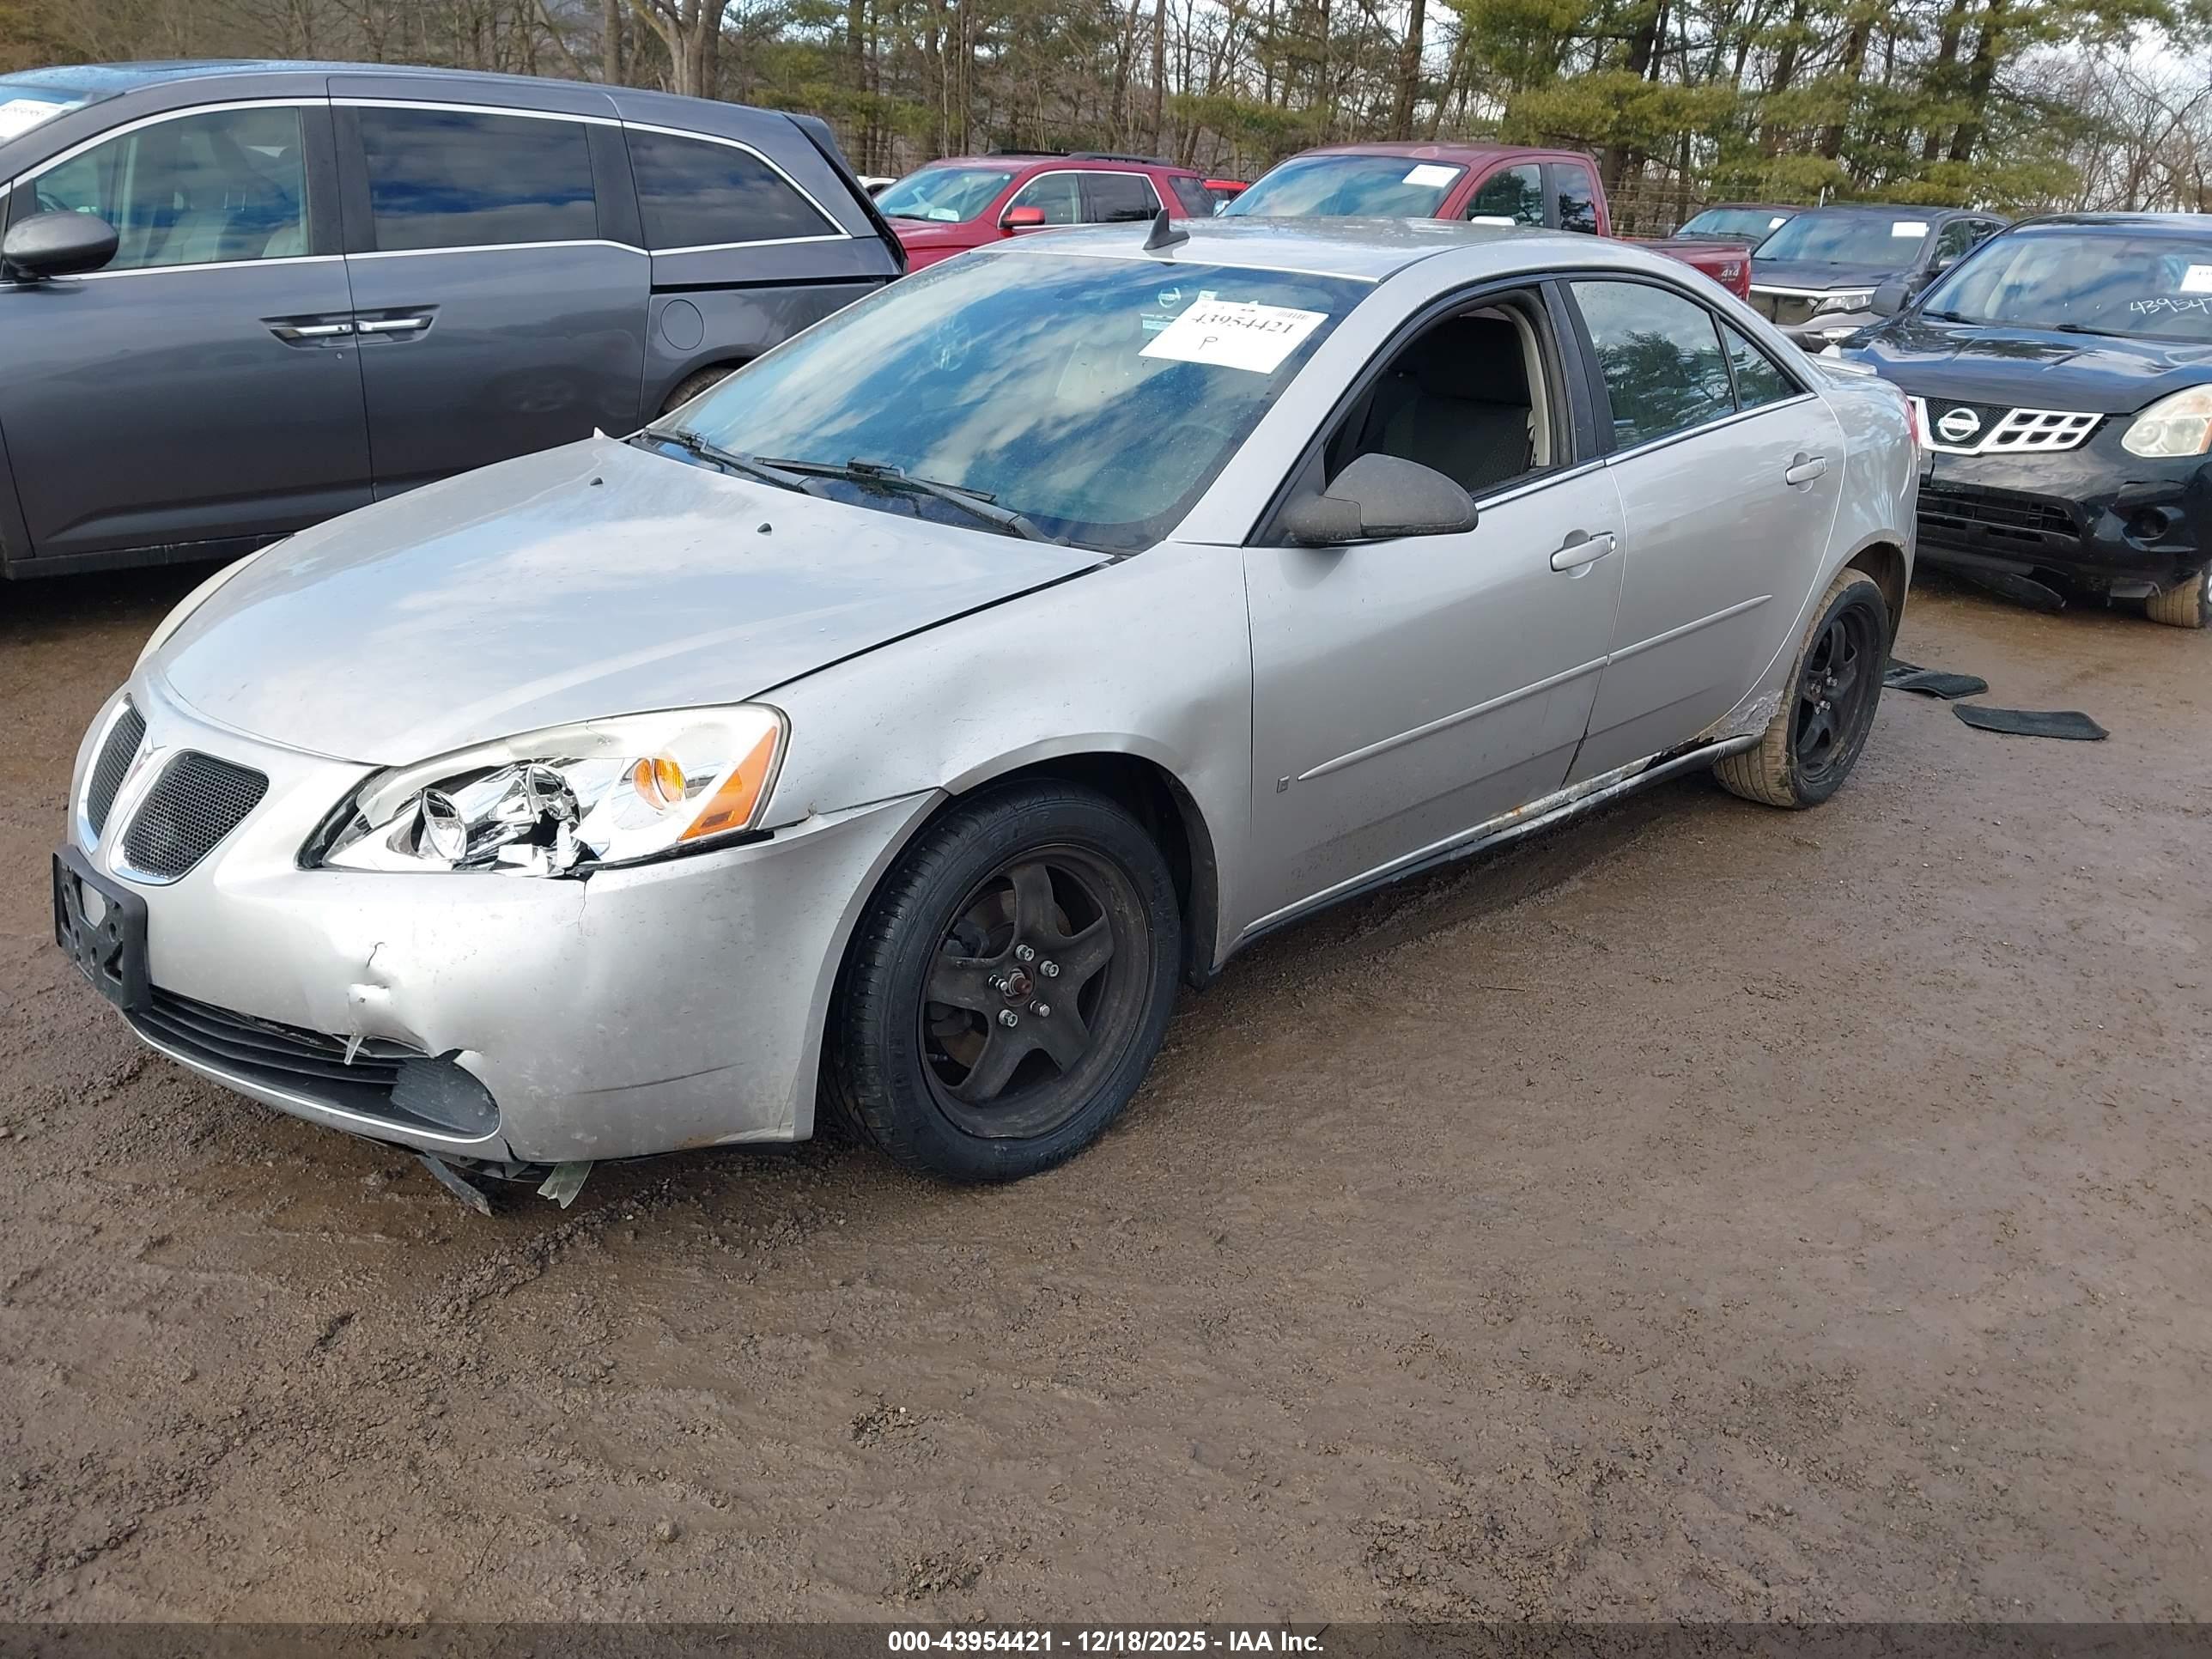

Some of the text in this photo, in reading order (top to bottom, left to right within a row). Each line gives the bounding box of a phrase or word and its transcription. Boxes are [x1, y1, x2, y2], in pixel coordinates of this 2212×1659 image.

[1721, 268, 1740, 276] 4x4
[1192, 313, 1294, 334] 43954421
[1199, 336, 1218, 350] P
